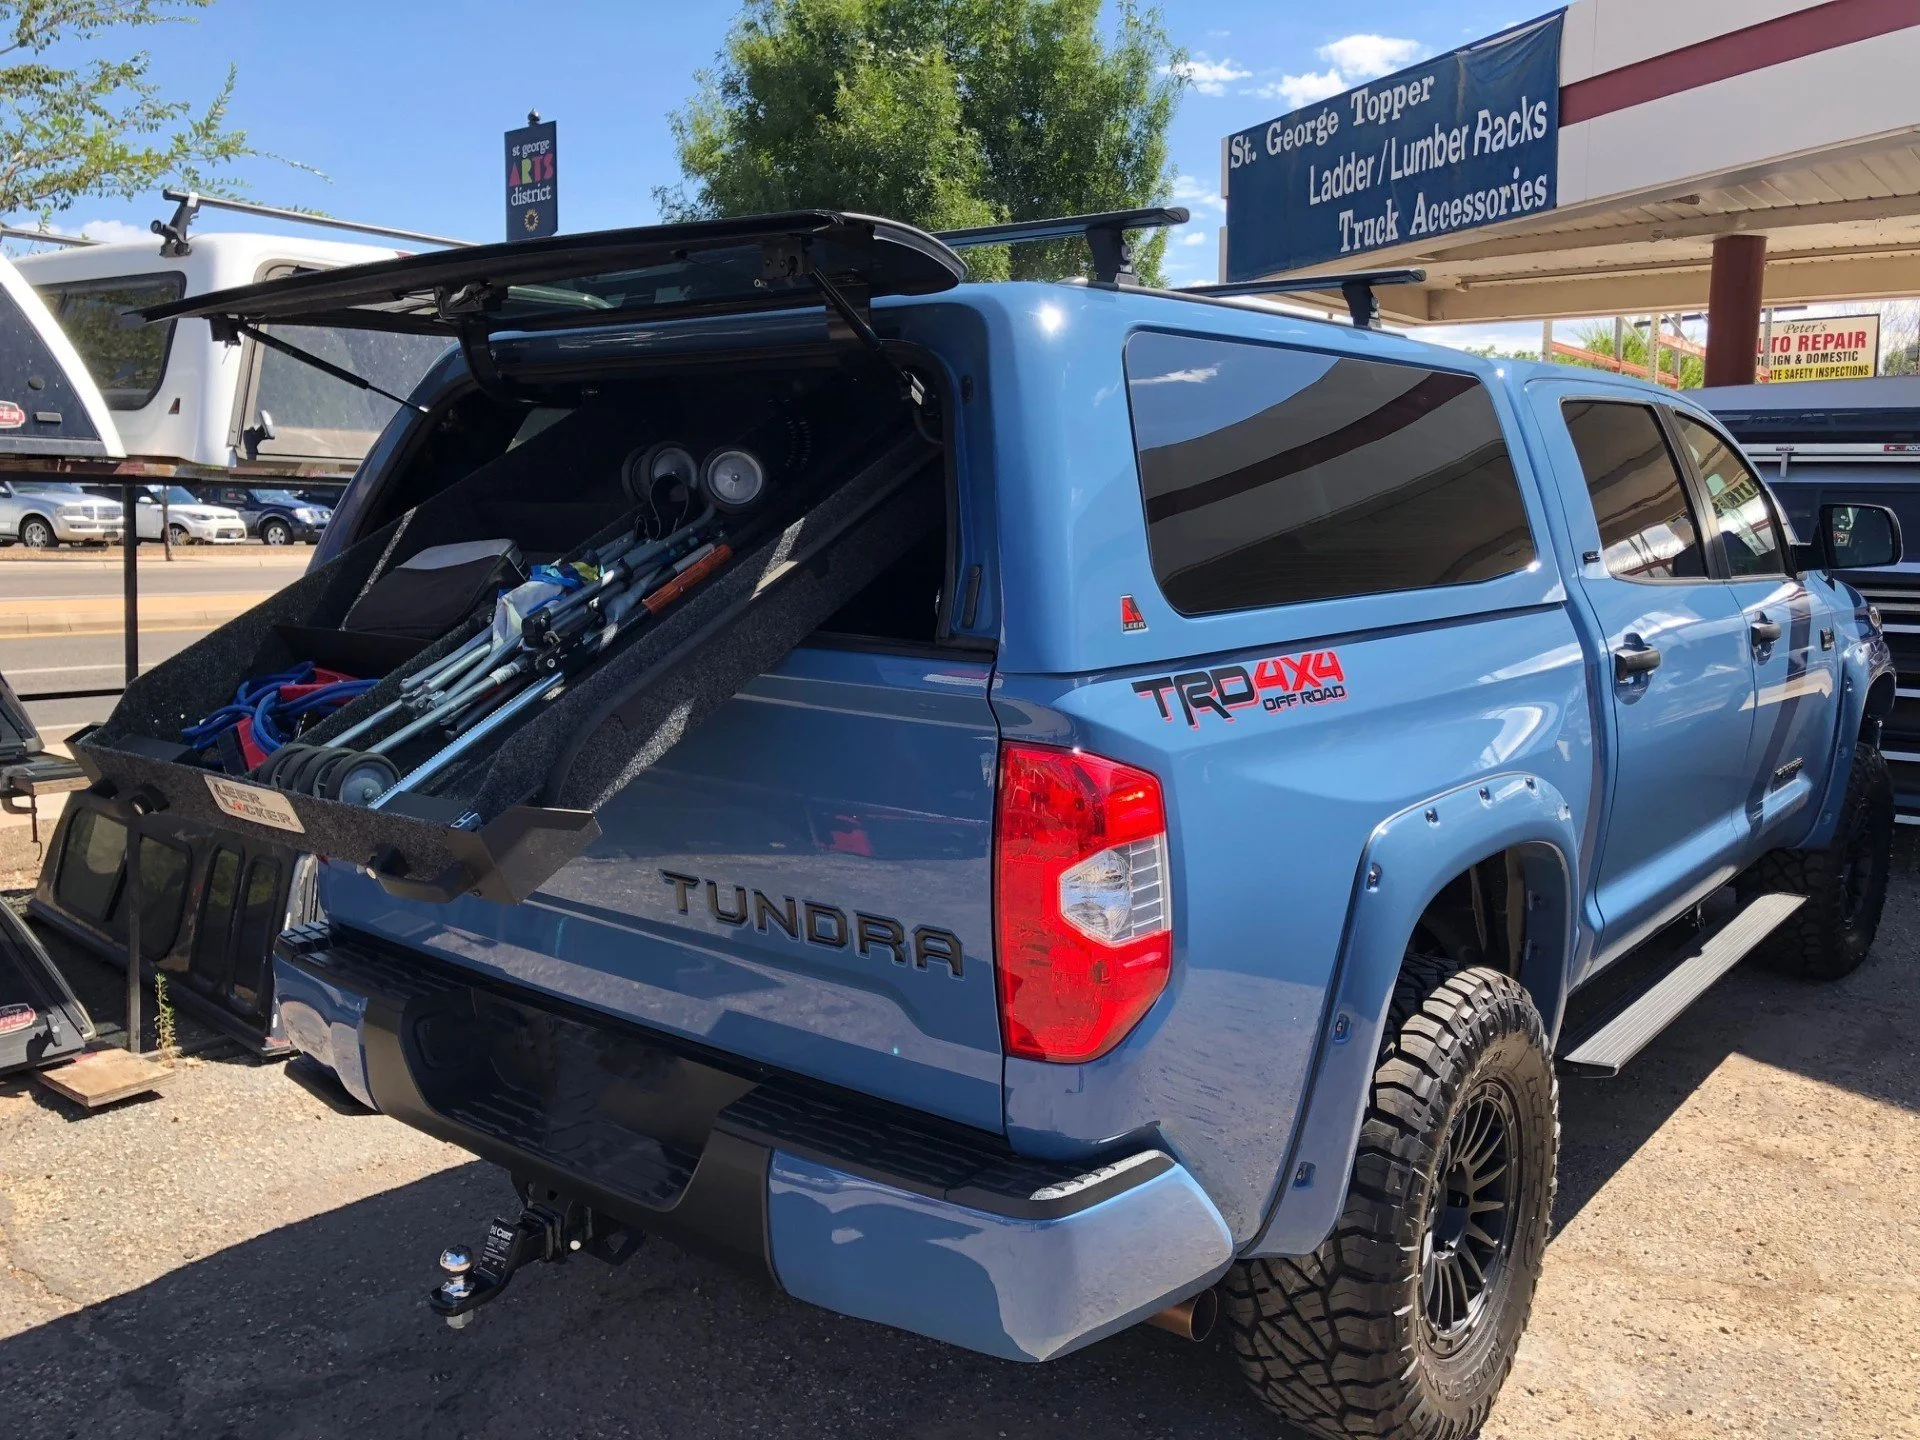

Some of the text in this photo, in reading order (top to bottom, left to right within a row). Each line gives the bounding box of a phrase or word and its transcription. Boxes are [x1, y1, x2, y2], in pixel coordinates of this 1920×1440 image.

[1230, 75, 1434, 169] St. George Topper
[1473, 96, 1547, 156] Racks
[522, 139, 550, 158] george
[509, 153, 554, 188] ARTS
[511, 184, 551, 206] district
[1338, 166, 1548, 253] Truck Accessories
[1784, 323, 1827, 335] Peter's
[1797, 331, 1867, 352] REPAIR
[1795, 354, 1803, 365] &
[1806, 351, 1859, 364] DOMESTIC
[1784, 367, 1813, 380] SAFETY
[1815, 365, 1869, 378] INSPECTIONS
[1123, 621, 1145, 630] LEER
[1131, 651, 1345, 729] TRD 4X4
[1262, 685, 1346, 712] OFF ROAD
[658, 868, 964, 979] TUNDRA
